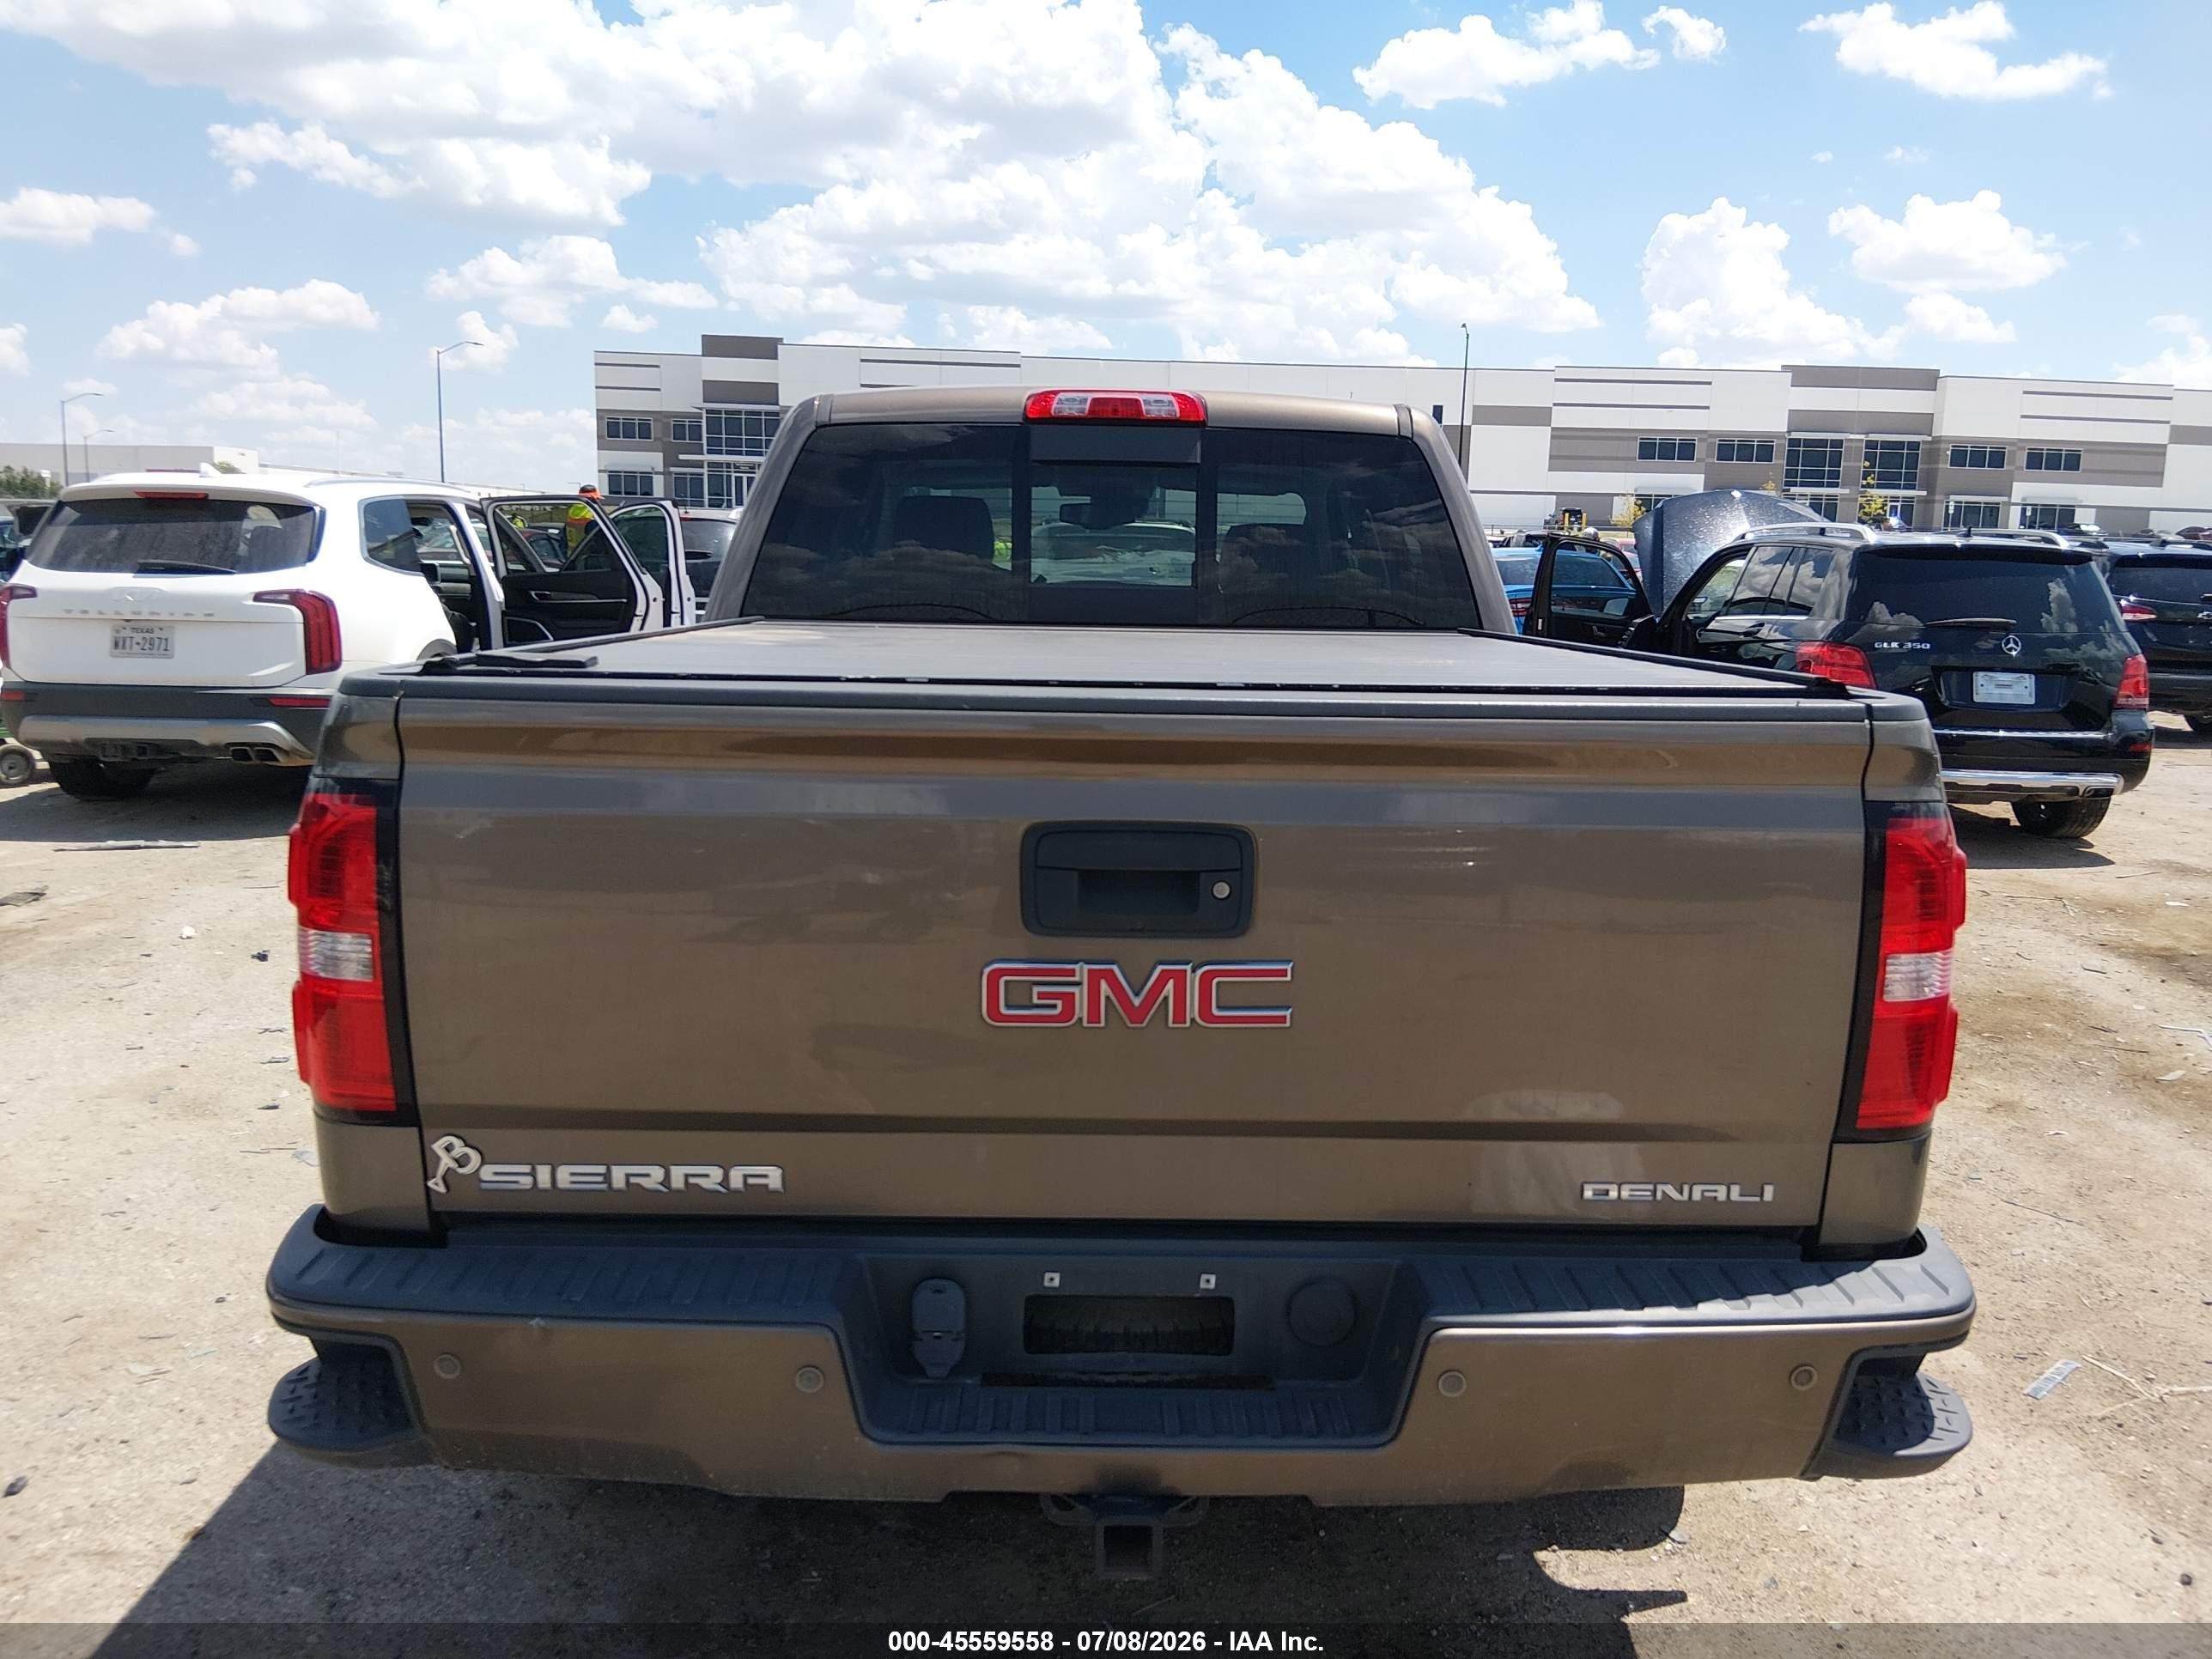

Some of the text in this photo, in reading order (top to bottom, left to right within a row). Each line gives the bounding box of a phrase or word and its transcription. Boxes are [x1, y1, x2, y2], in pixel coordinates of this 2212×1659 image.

[981, 959, 1293, 1027] GMC
[479, 1164, 783, 1194] SIERRA
[1582, 1182, 1775, 1202] DENALI
